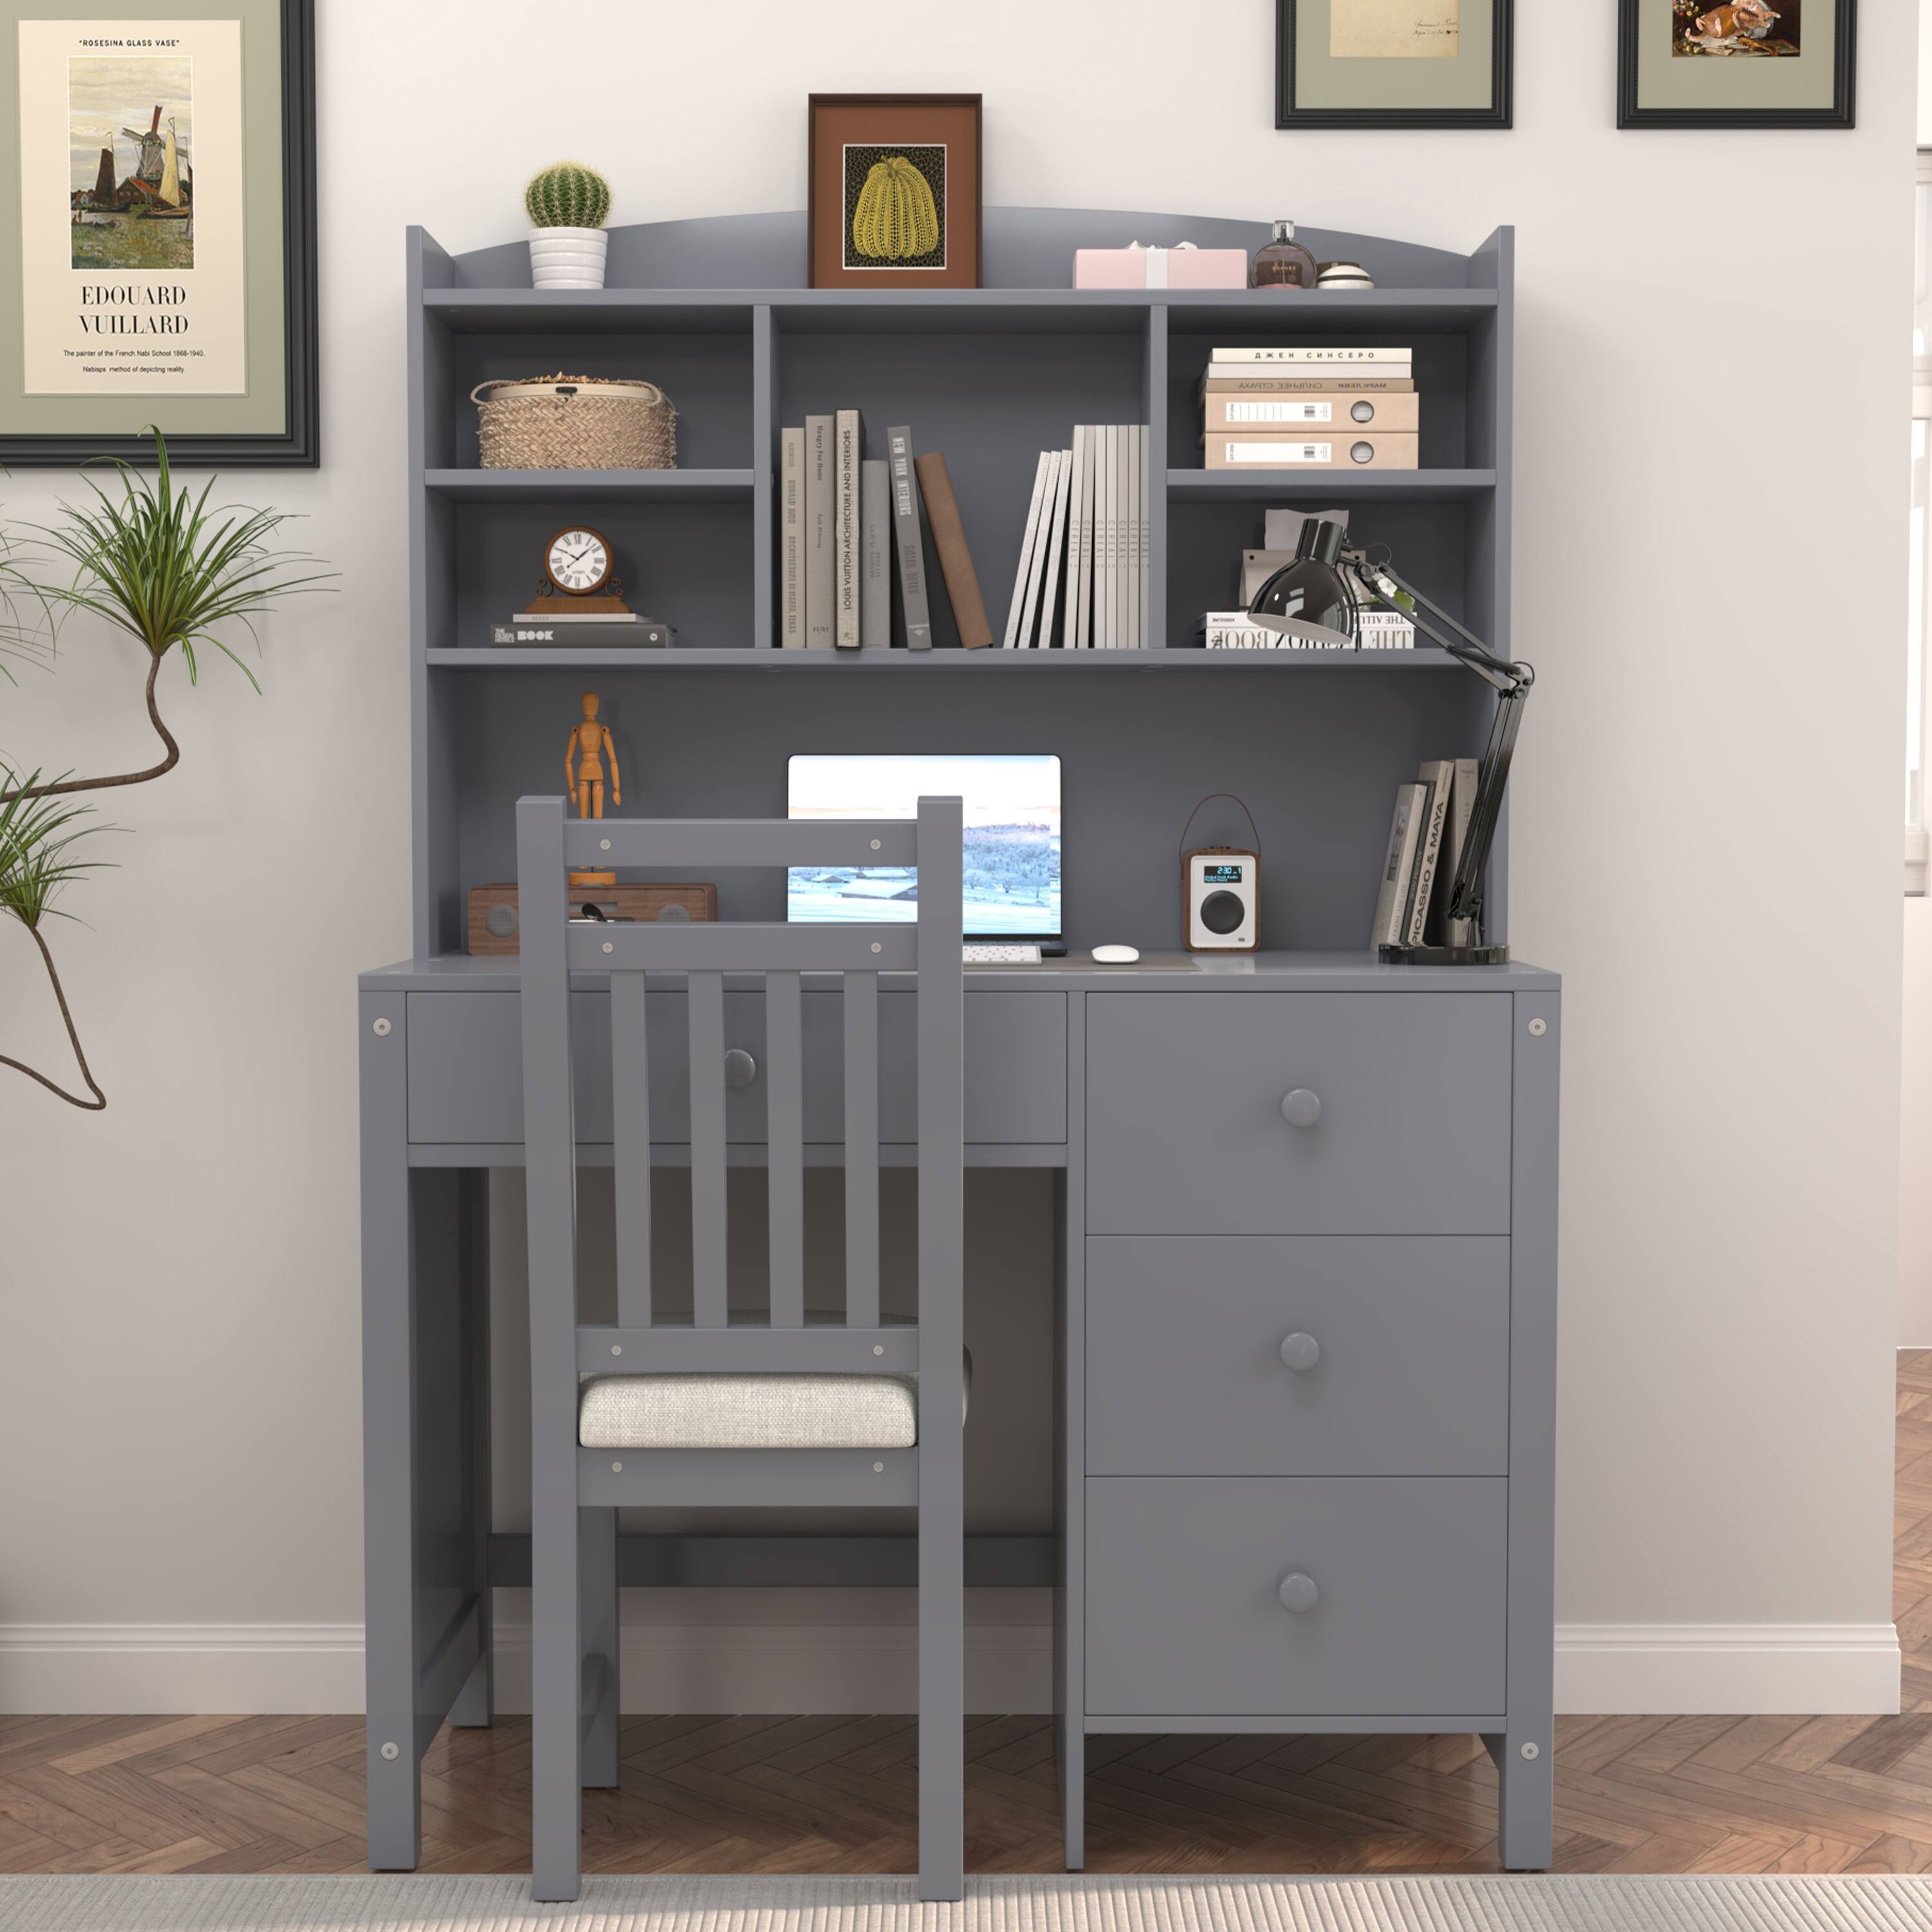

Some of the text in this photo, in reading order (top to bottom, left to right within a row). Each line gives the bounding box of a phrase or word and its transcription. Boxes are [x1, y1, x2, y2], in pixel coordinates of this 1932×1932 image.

[81, 285, 186, 305] EDOUARD
[78, 314, 189, 334] VUILLARD
[815, 425, 824, 448] Hungry
[893, 437, 912, 515] NEW YORK INTERIORS
[788, 480, 796, 506] DONALD
[788, 508, 796, 524] JUDD
[1070, 520, 1079, 558] CEREAL
[1082, 520, 1091, 558] CEREAL
[788, 536, 797, 582] ARCHITECTURE
[788, 615, 797, 634] TEXAS
[1385, 615, 1405, 624] THE
[517, 630, 554, 640] BOOK
[1429, 802, 1444, 848] MAYA
[1427, 853, 1435, 864] &
[1412, 869, 1431, 943] PICASSO
